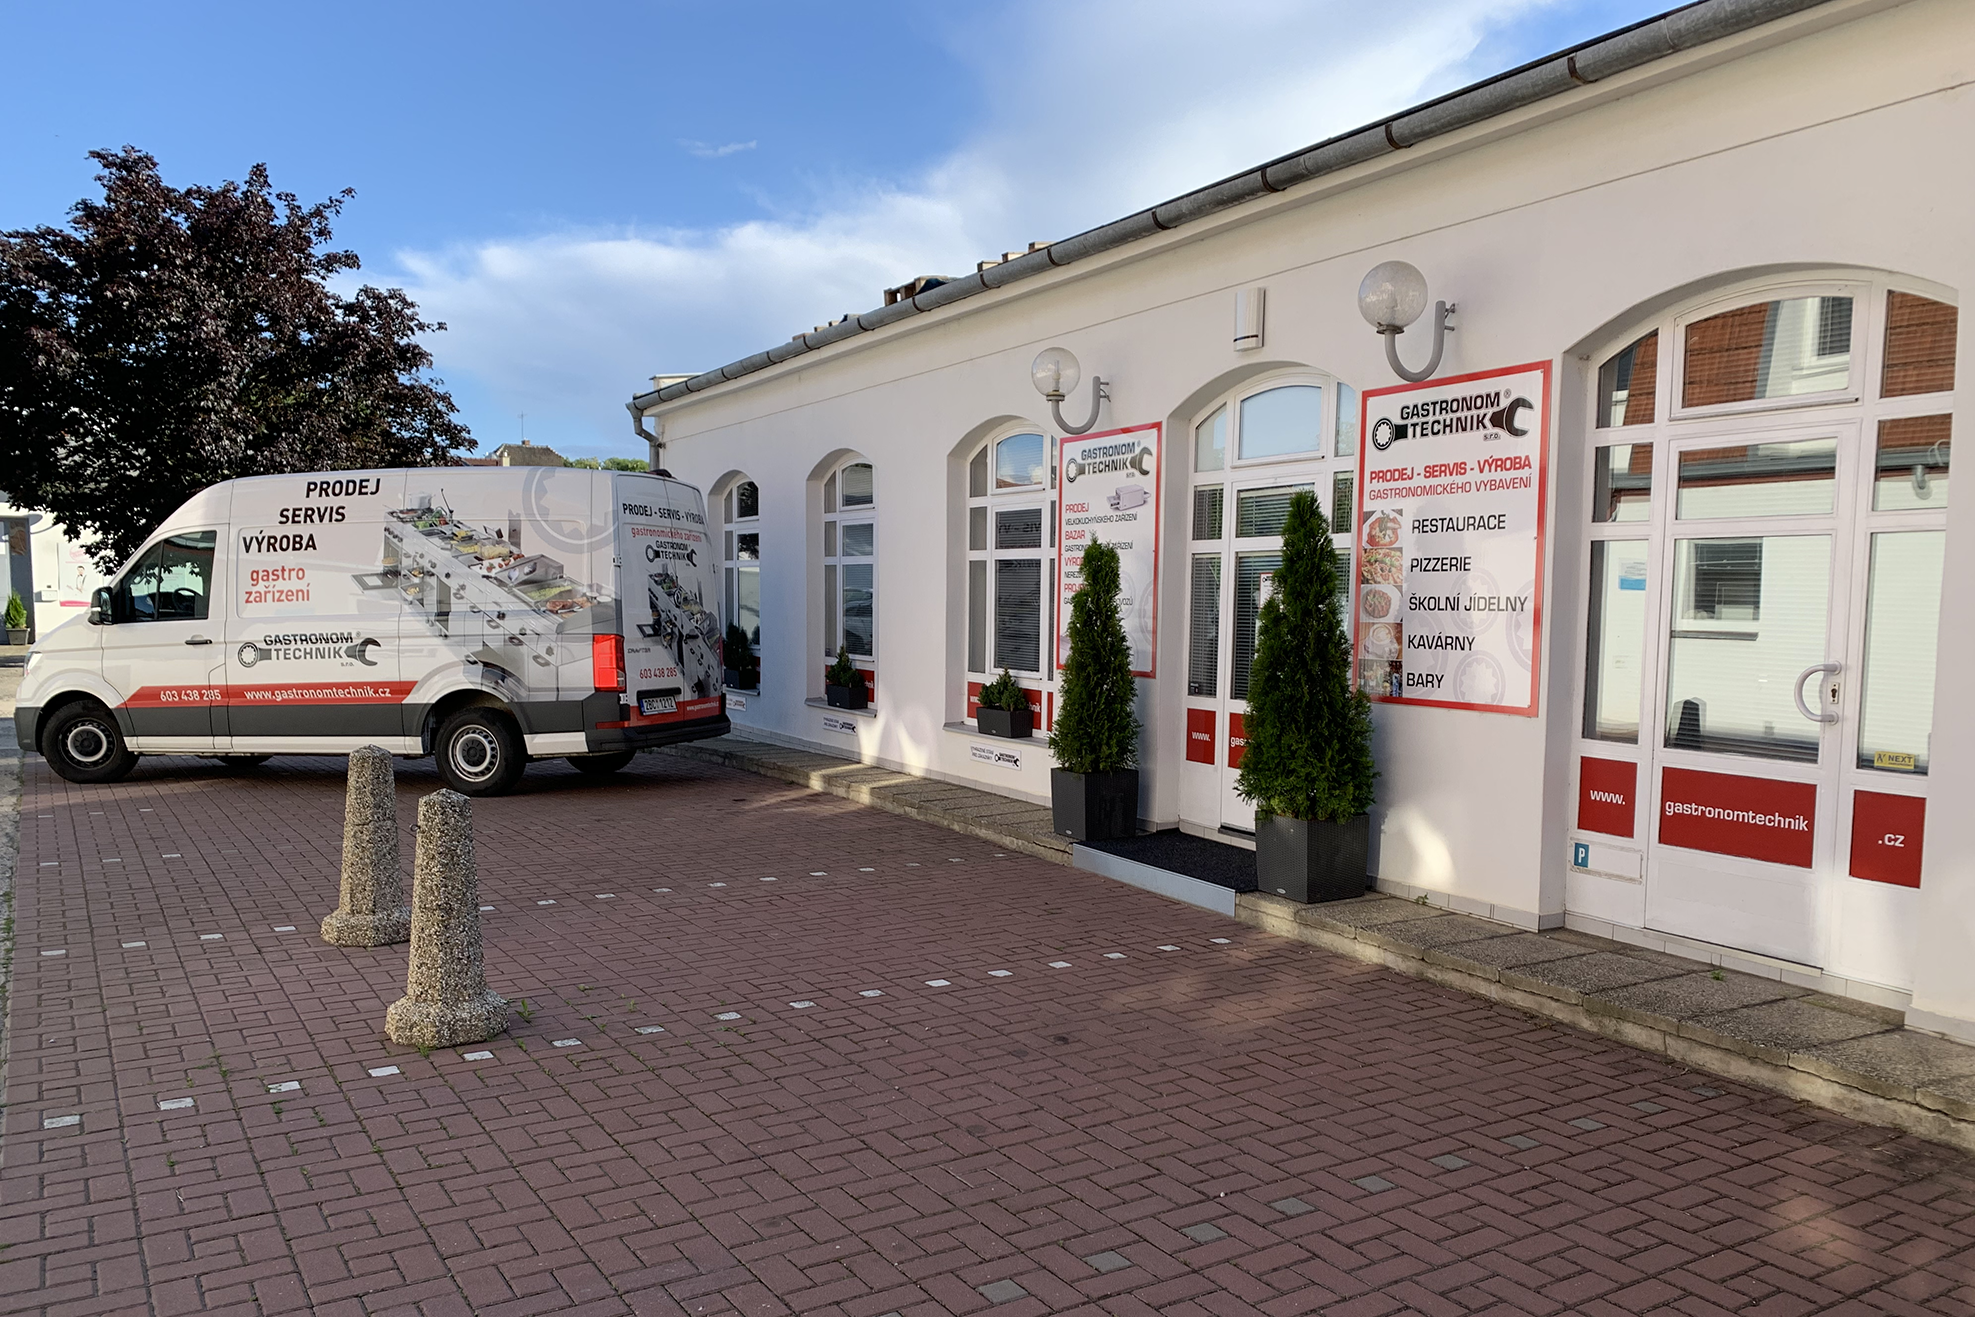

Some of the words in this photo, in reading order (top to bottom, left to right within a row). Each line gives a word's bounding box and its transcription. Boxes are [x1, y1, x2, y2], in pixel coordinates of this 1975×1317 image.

[1400, 391, 1500, 421] GASTRONOM
[1410, 412, 1488, 439] TECHNIK
[1081, 442, 1136, 461] GASTRONOM
[1087, 457, 1129, 475] TECHNIK
[1369, 466, 1414, 484] PRODEJ
[1424, 461, 1467, 479] SERVIS
[1477, 455, 1532, 474] VÝROBA
[305, 478, 381, 498] PRODEJ
[1369, 479, 1472, 500] GASTRONOMICKÉHO
[1475, 473, 1532, 492] VYBAVENÍ
[278, 505, 346, 524] SERVIS
[622, 503, 653, 517] PRODEJ
[658, 507, 681, 521] SERVIS
[1065, 502, 1089, 514] PRODEJ
[1411, 513, 1506, 534] RESTAURACE
[242, 530, 317, 553] VÝROBA
[1065, 530, 1085, 540] BAZAR
[655, 540, 688, 551] GASTRONOM
[660, 550, 686, 561] TECHNIK
[1410, 556, 1472, 573] PIZZERIE
[250, 565, 306, 587] gastro
[245, 582, 310, 604] zařízení
[1408, 592, 1460, 611] ŠKOLNÍ
[1464, 592, 1528, 612] JÍDELNY
[263, 632, 353, 646] GASTRONOM
[1407, 631, 1475, 652] KAVÁRNY
[274, 646, 343, 660] TECHNIK
[640, 668, 652, 679] 603
[653, 667, 665, 678] 438
[666, 666, 677, 677] 285
[1406, 672, 1444, 689] BARY
[160, 690, 179, 702] 603
[181, 689, 200, 701] 438
[201, 689, 221, 701] 285
[244, 686, 391, 701] www.gastronomtechnik.cz
[1191, 731, 1211, 742] www.
[1888, 754, 1913, 763] NEXT
[1589, 788, 1626, 805] www.
[1665, 800, 1809, 832] gastronomtechnik
[1877, 831, 1906, 848] .cz
[1578, 847, 1586, 863] P
